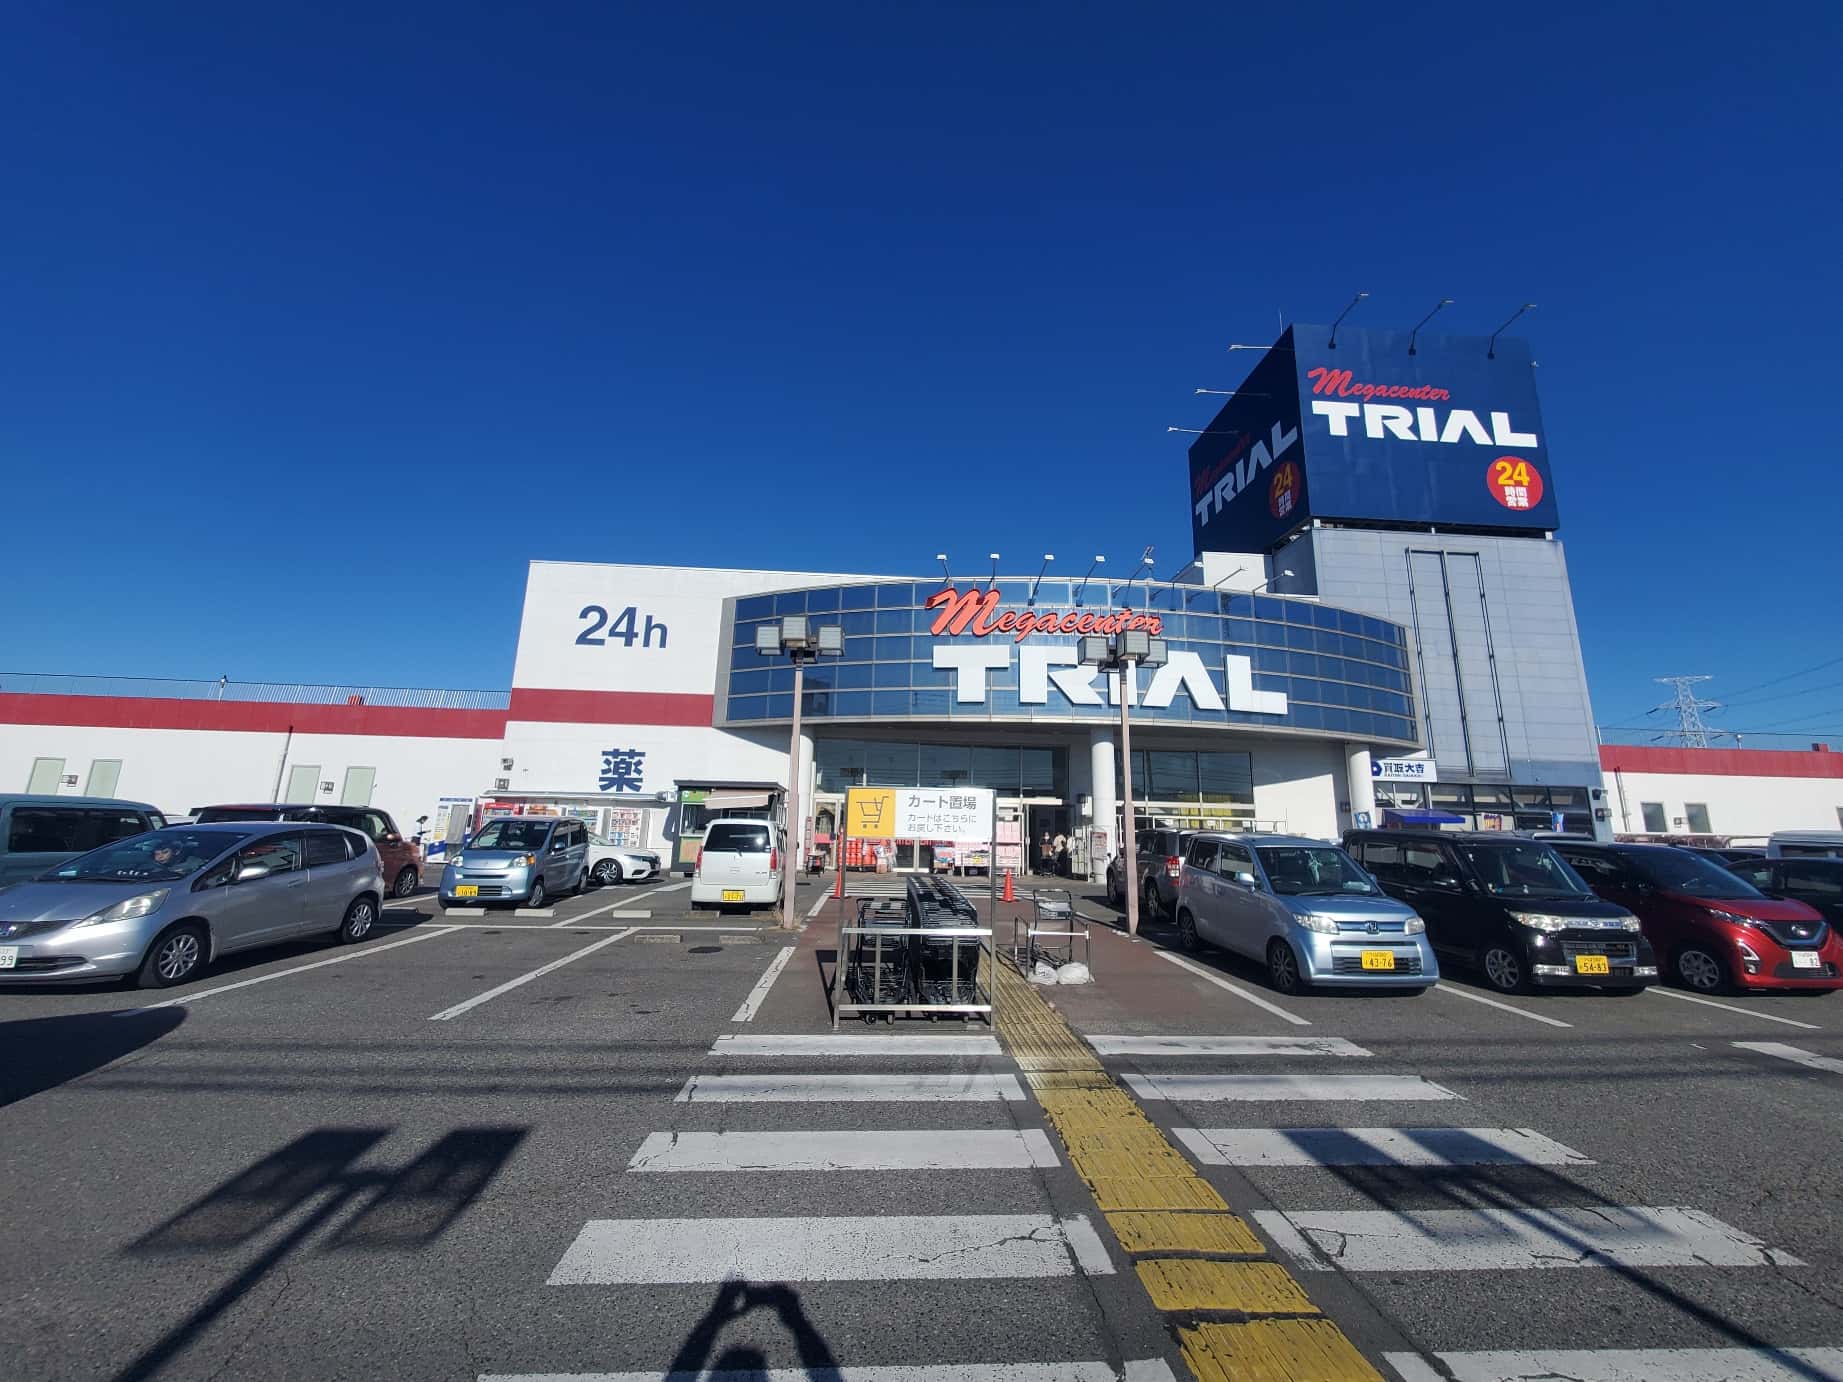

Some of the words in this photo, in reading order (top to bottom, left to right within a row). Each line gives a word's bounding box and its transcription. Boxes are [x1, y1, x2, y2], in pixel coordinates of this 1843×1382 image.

[1307, 367, 1450, 401] Megacenter
[1311, 400, 1538, 448] TRIAL
[1195, 420, 1298, 527] TRIAL
[1273, 463, 1293, 498] 24
[1495, 461, 1530, 486] 24
[575, 604, 668, 648] 24h
[925, 588, 1164, 643] Megacenter
[598, 748, 646, 792] 薬
[908, 795, 977, 810] カート置場
[908, 813, 977, 824] カートはこちらに
